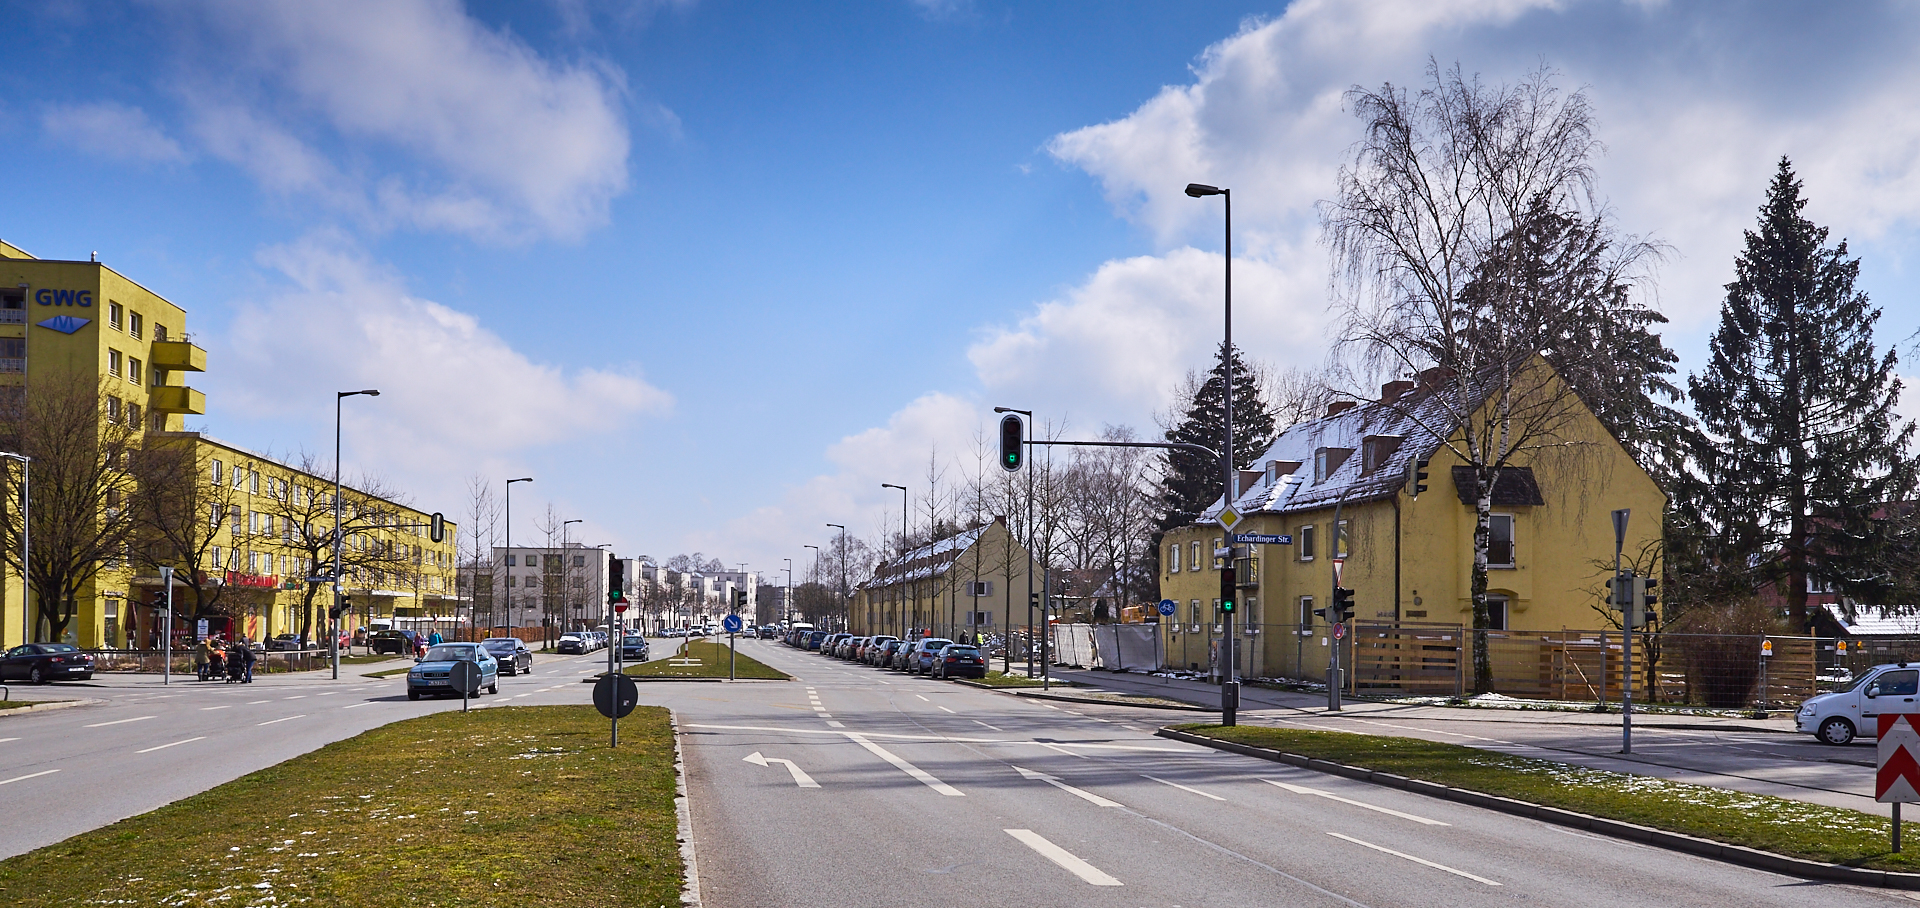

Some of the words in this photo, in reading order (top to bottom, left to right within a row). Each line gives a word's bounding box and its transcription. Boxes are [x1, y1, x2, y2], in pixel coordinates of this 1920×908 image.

[35, 288, 92, 307] GWG
[1237, 534, 1276, 544] Echardinger
[1277, 535, 1290, 543] Str.
